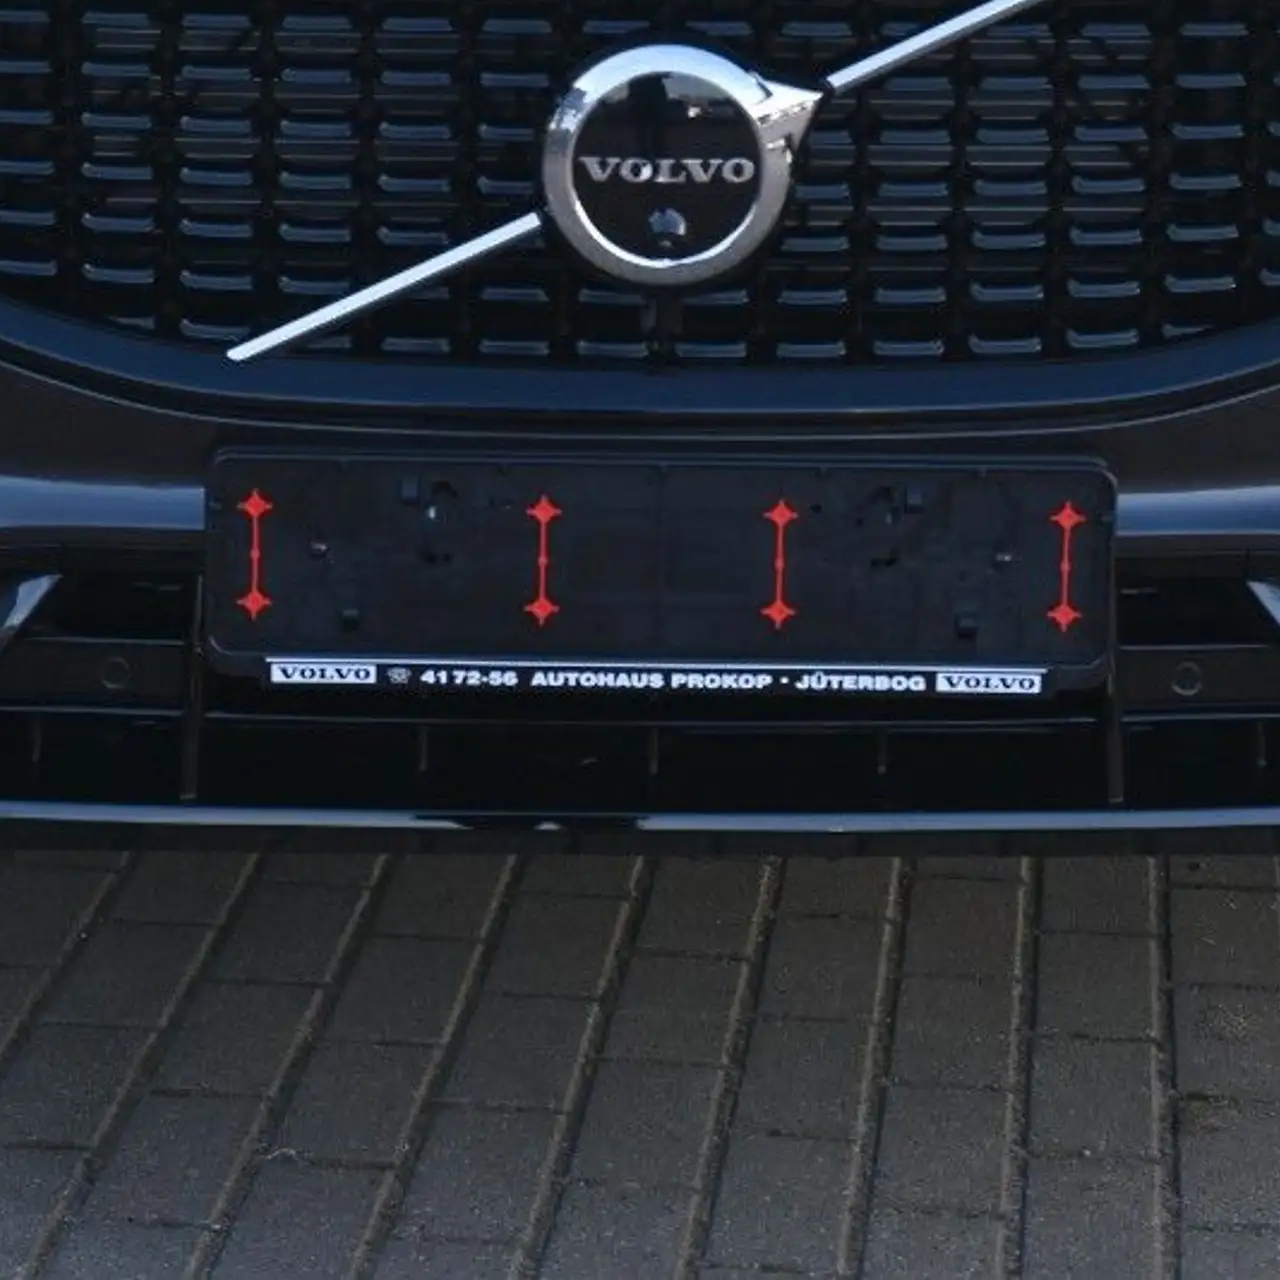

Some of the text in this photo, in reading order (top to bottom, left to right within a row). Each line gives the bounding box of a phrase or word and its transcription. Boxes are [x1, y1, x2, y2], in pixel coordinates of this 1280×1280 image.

[579, 156, 755, 184] VOLVO
[278, 666, 371, 681] VOLVO
[530, 671, 665, 688] AUTOHAUS
[671, 673, 773, 690] PROKOP
[795, 671, 927, 692] JÜTERBOG
[941, 674, 1036, 691] VOLVO
